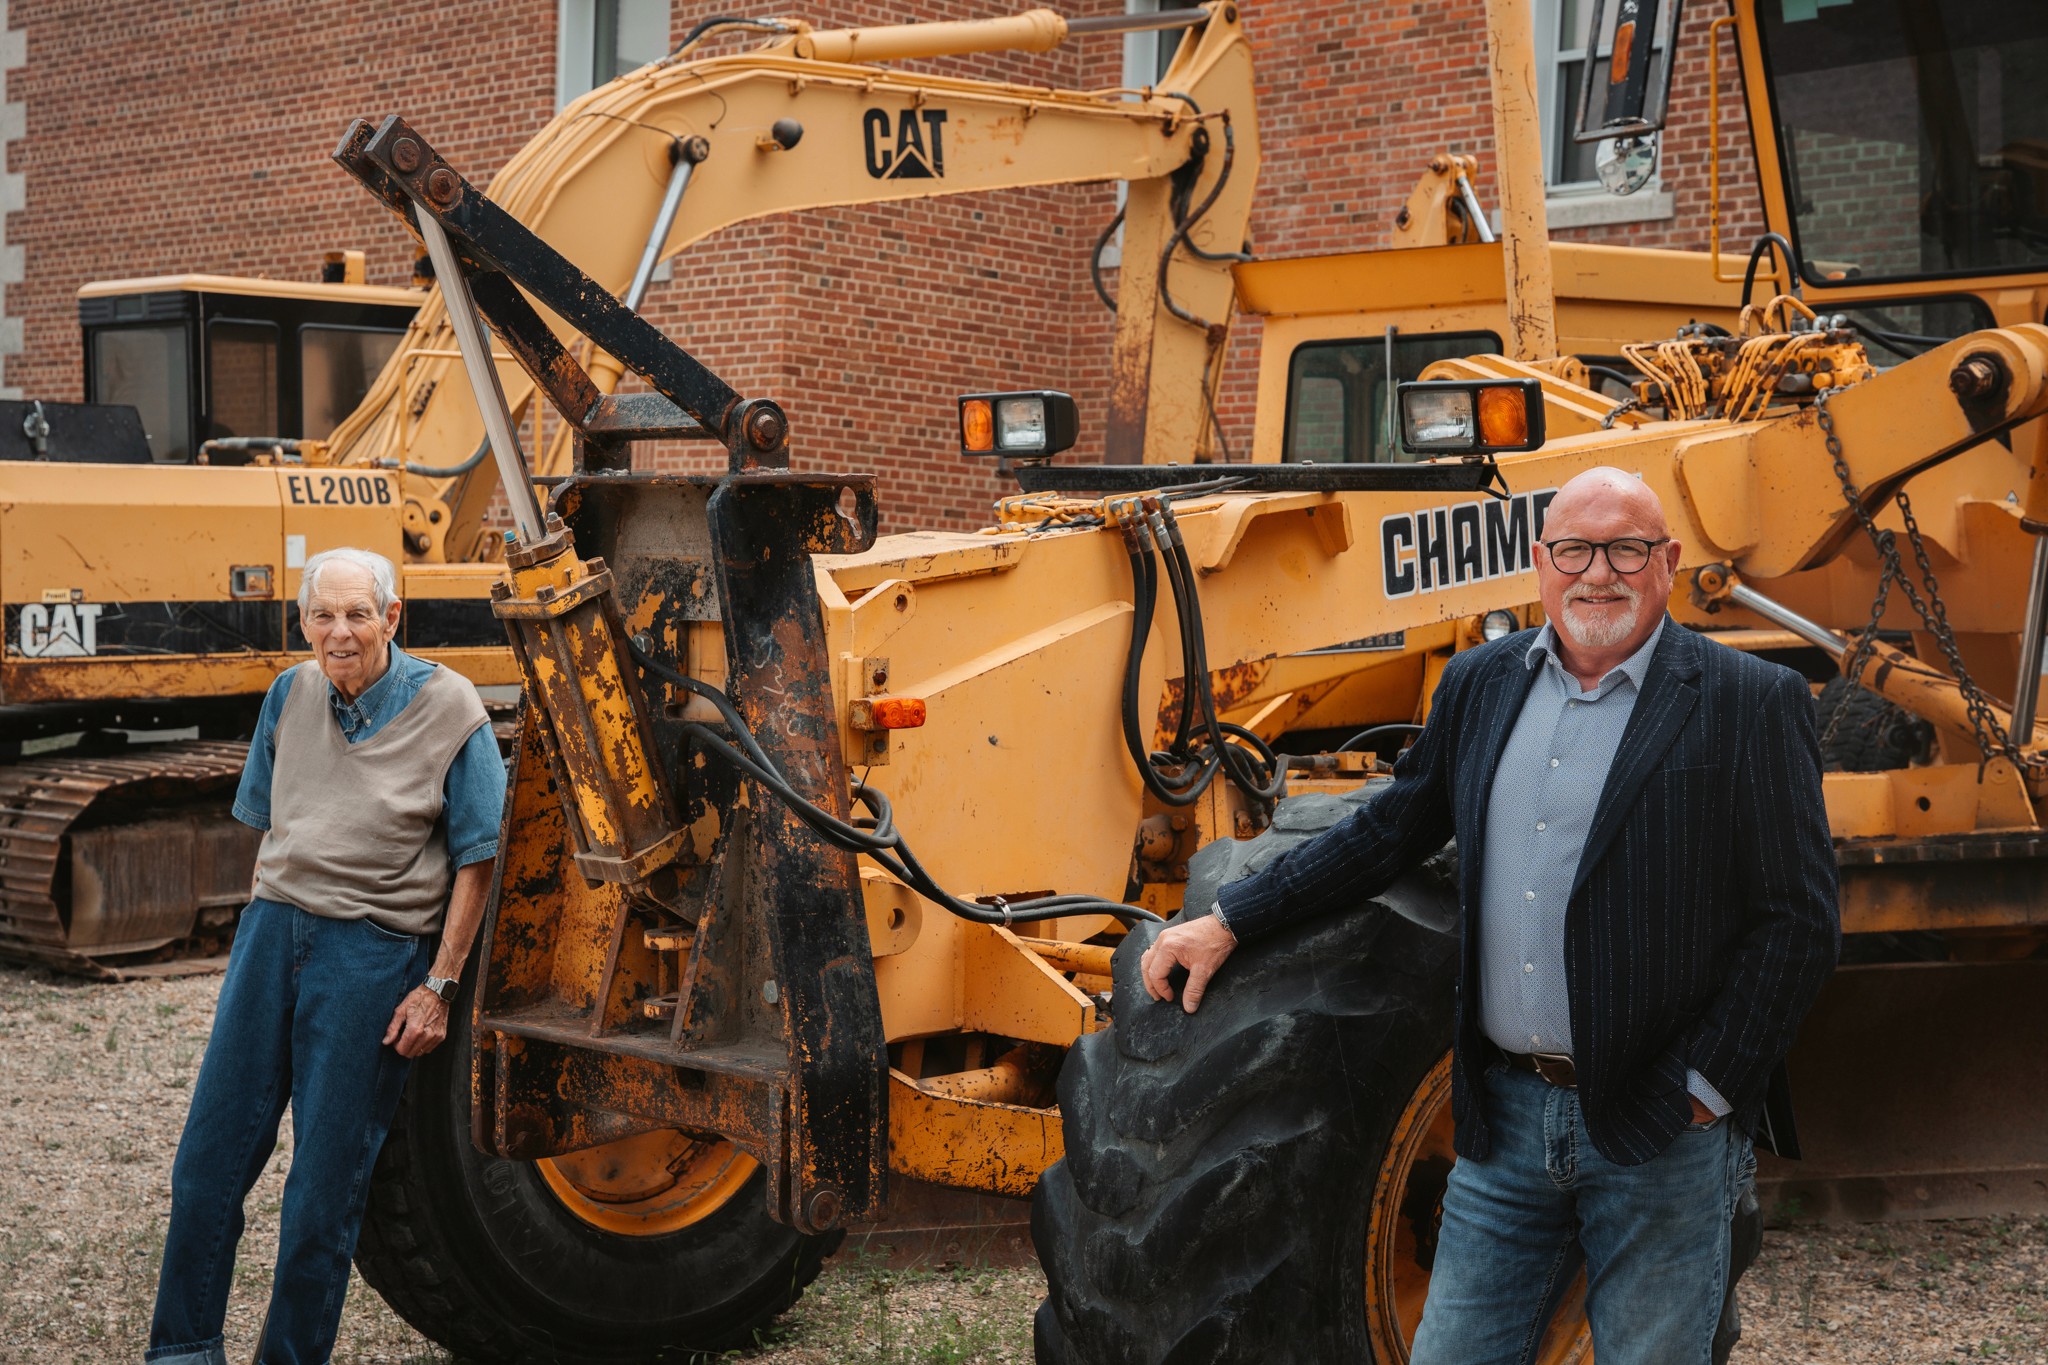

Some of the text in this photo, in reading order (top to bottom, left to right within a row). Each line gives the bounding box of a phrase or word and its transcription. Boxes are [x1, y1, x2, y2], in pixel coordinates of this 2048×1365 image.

[863, 107, 948, 179] CAT
[288, 476, 391, 505] EL200B
[1380, 487, 1562, 600] CHAMP
[20, 603, 102, 657] CAT
